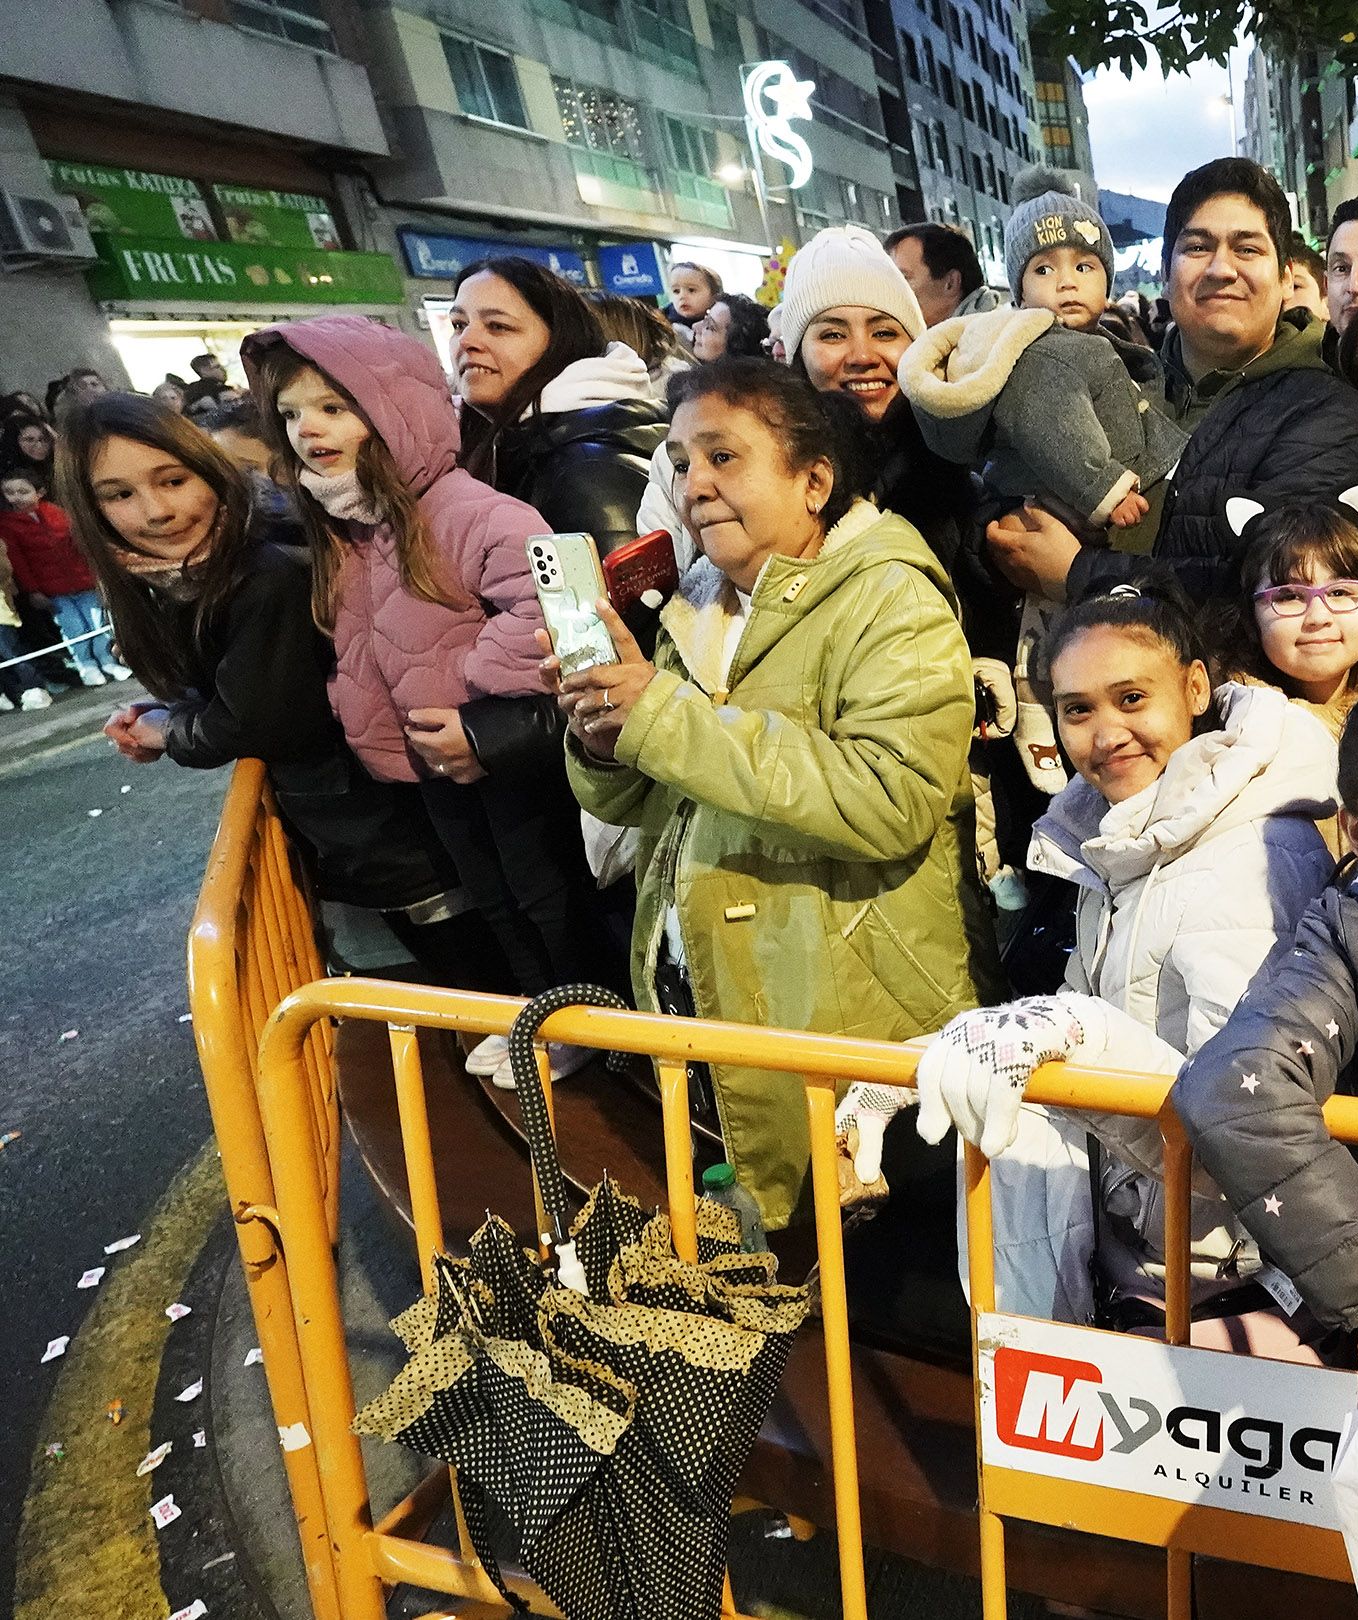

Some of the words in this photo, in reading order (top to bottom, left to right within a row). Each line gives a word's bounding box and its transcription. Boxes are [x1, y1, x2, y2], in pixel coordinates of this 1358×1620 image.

[1034, 215, 1063, 232] LION
[1038, 227, 1067, 246] KING
[122, 250, 238, 285] FRUTAS
[1153, 1463, 1315, 1506] ALQUILER
